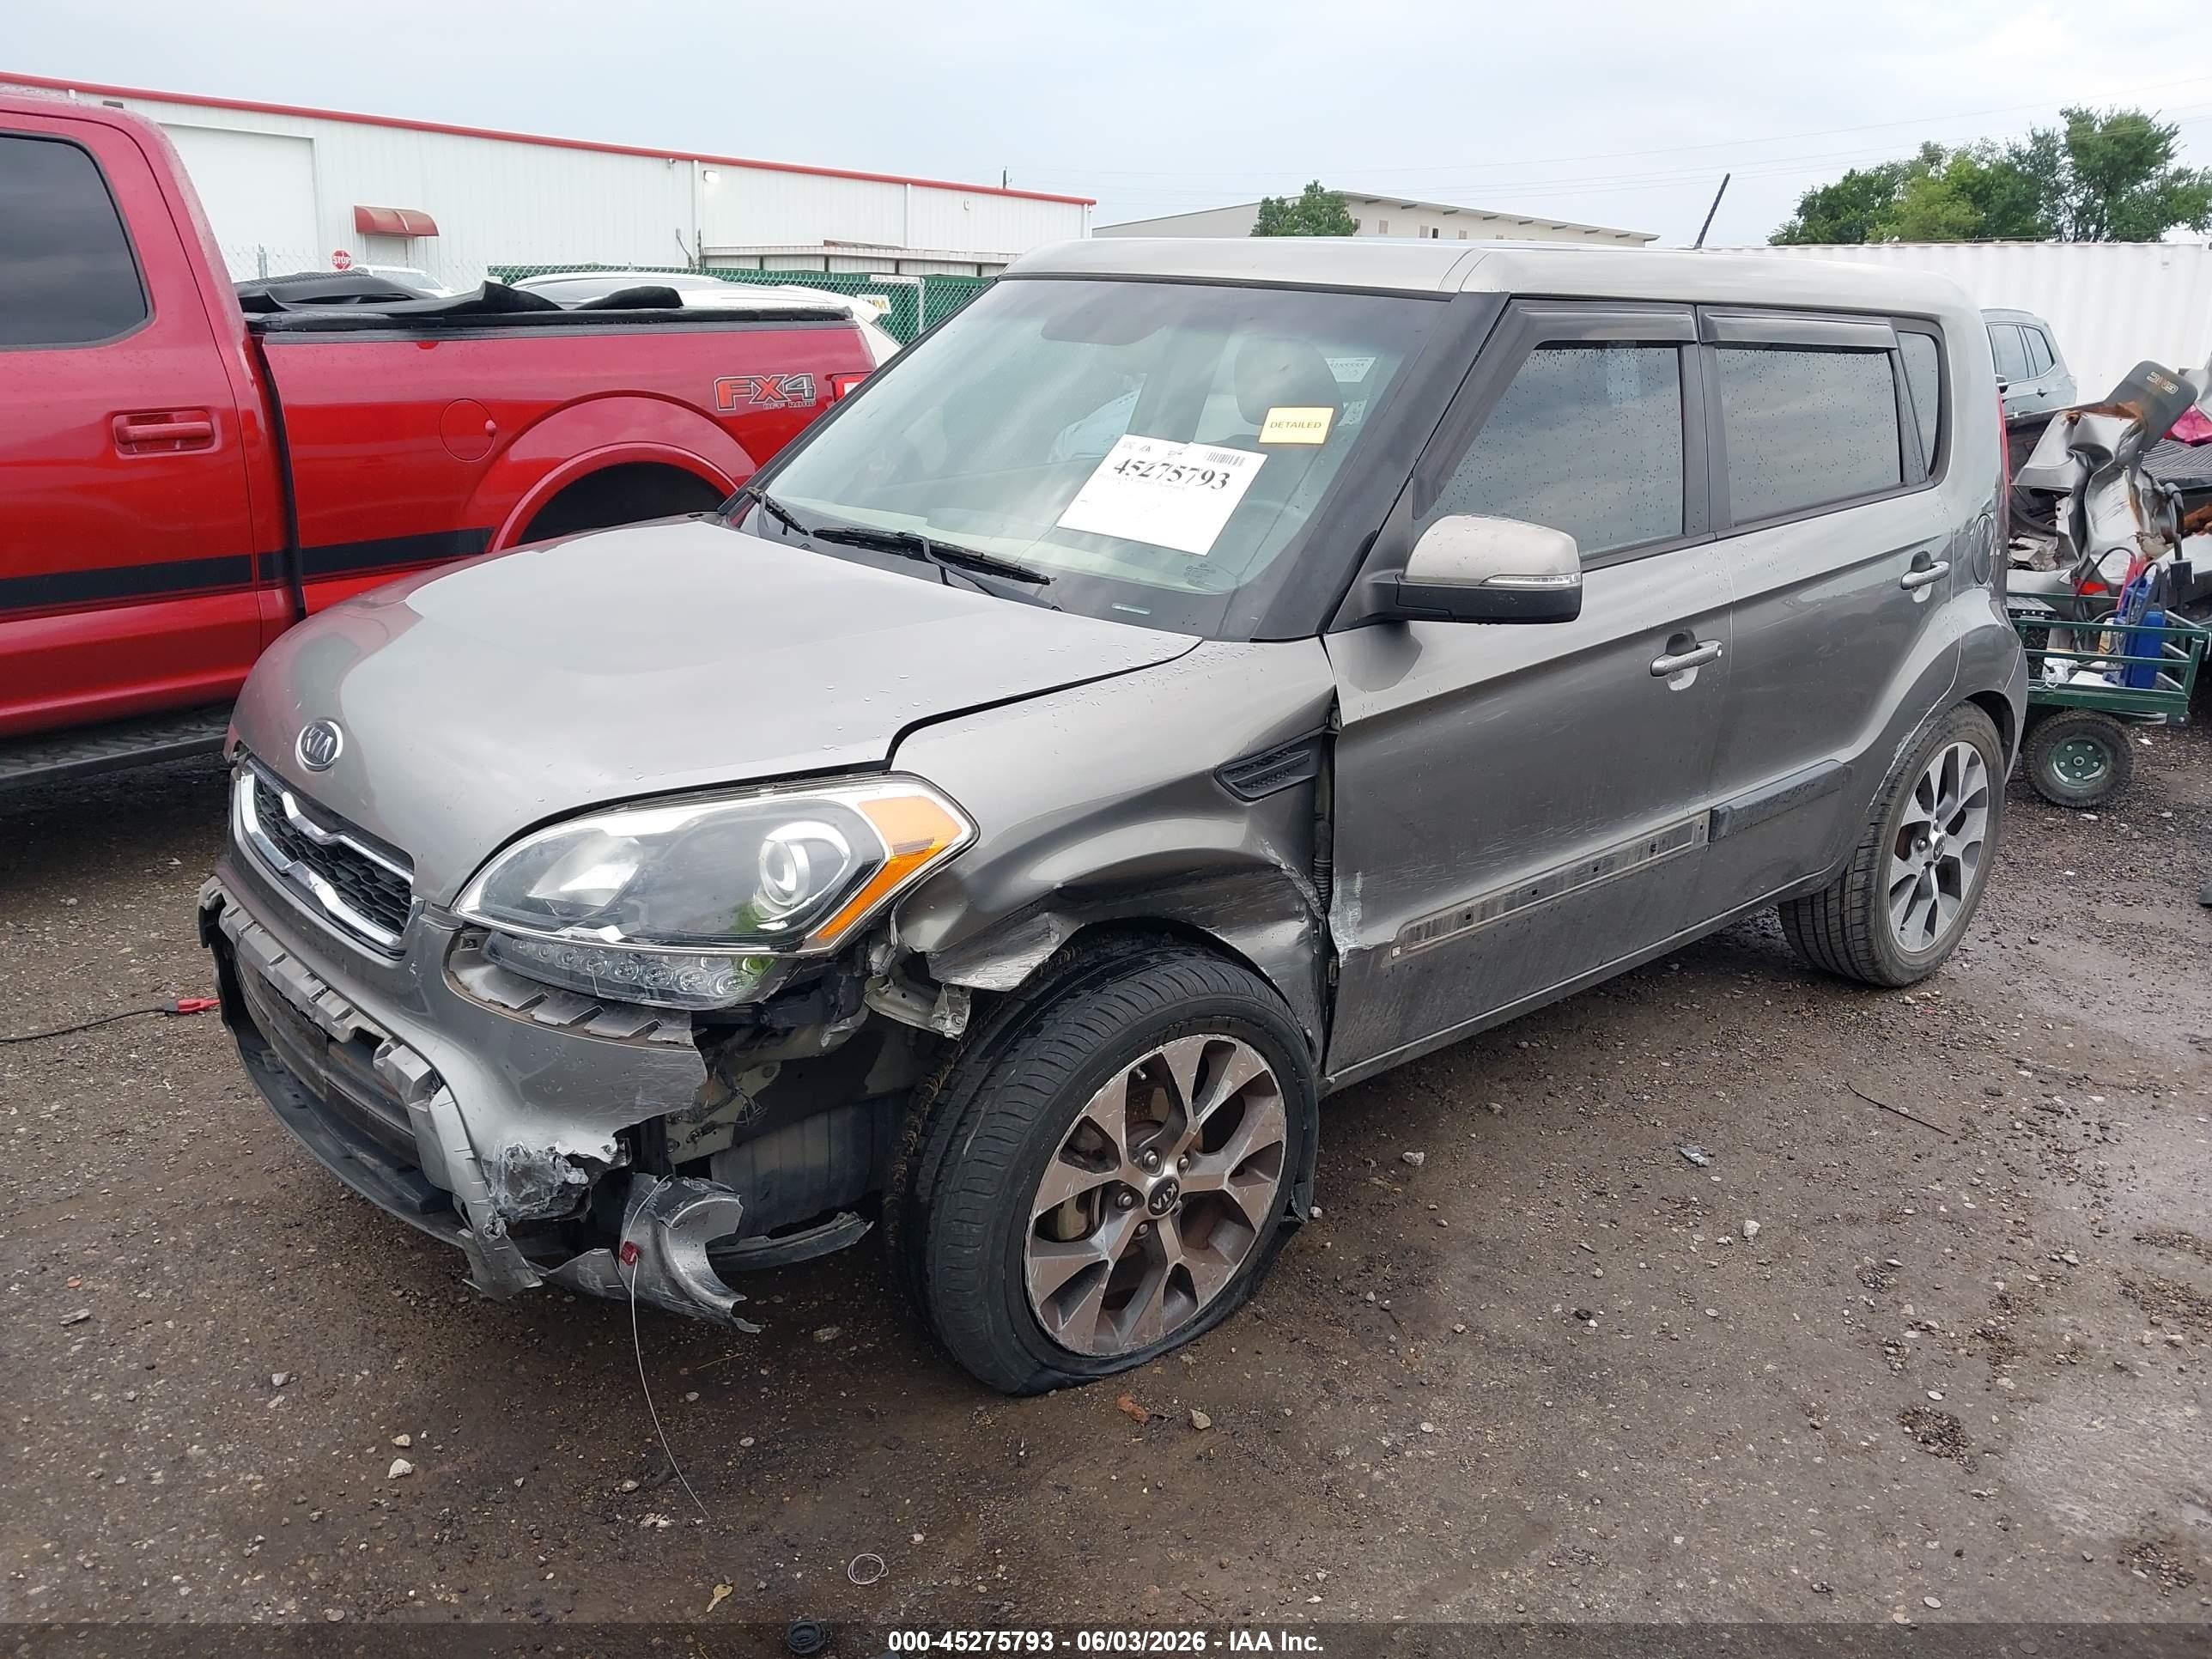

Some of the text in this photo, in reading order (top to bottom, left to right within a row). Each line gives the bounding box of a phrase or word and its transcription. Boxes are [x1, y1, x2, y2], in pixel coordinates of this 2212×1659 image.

[332, 255, 351, 265] STOP
[714, 374, 817, 410] FX4
[1114, 458, 1231, 489] 45275793
[302, 726, 333, 763] KIA
[1152, 1182, 1177, 1209] KIA
